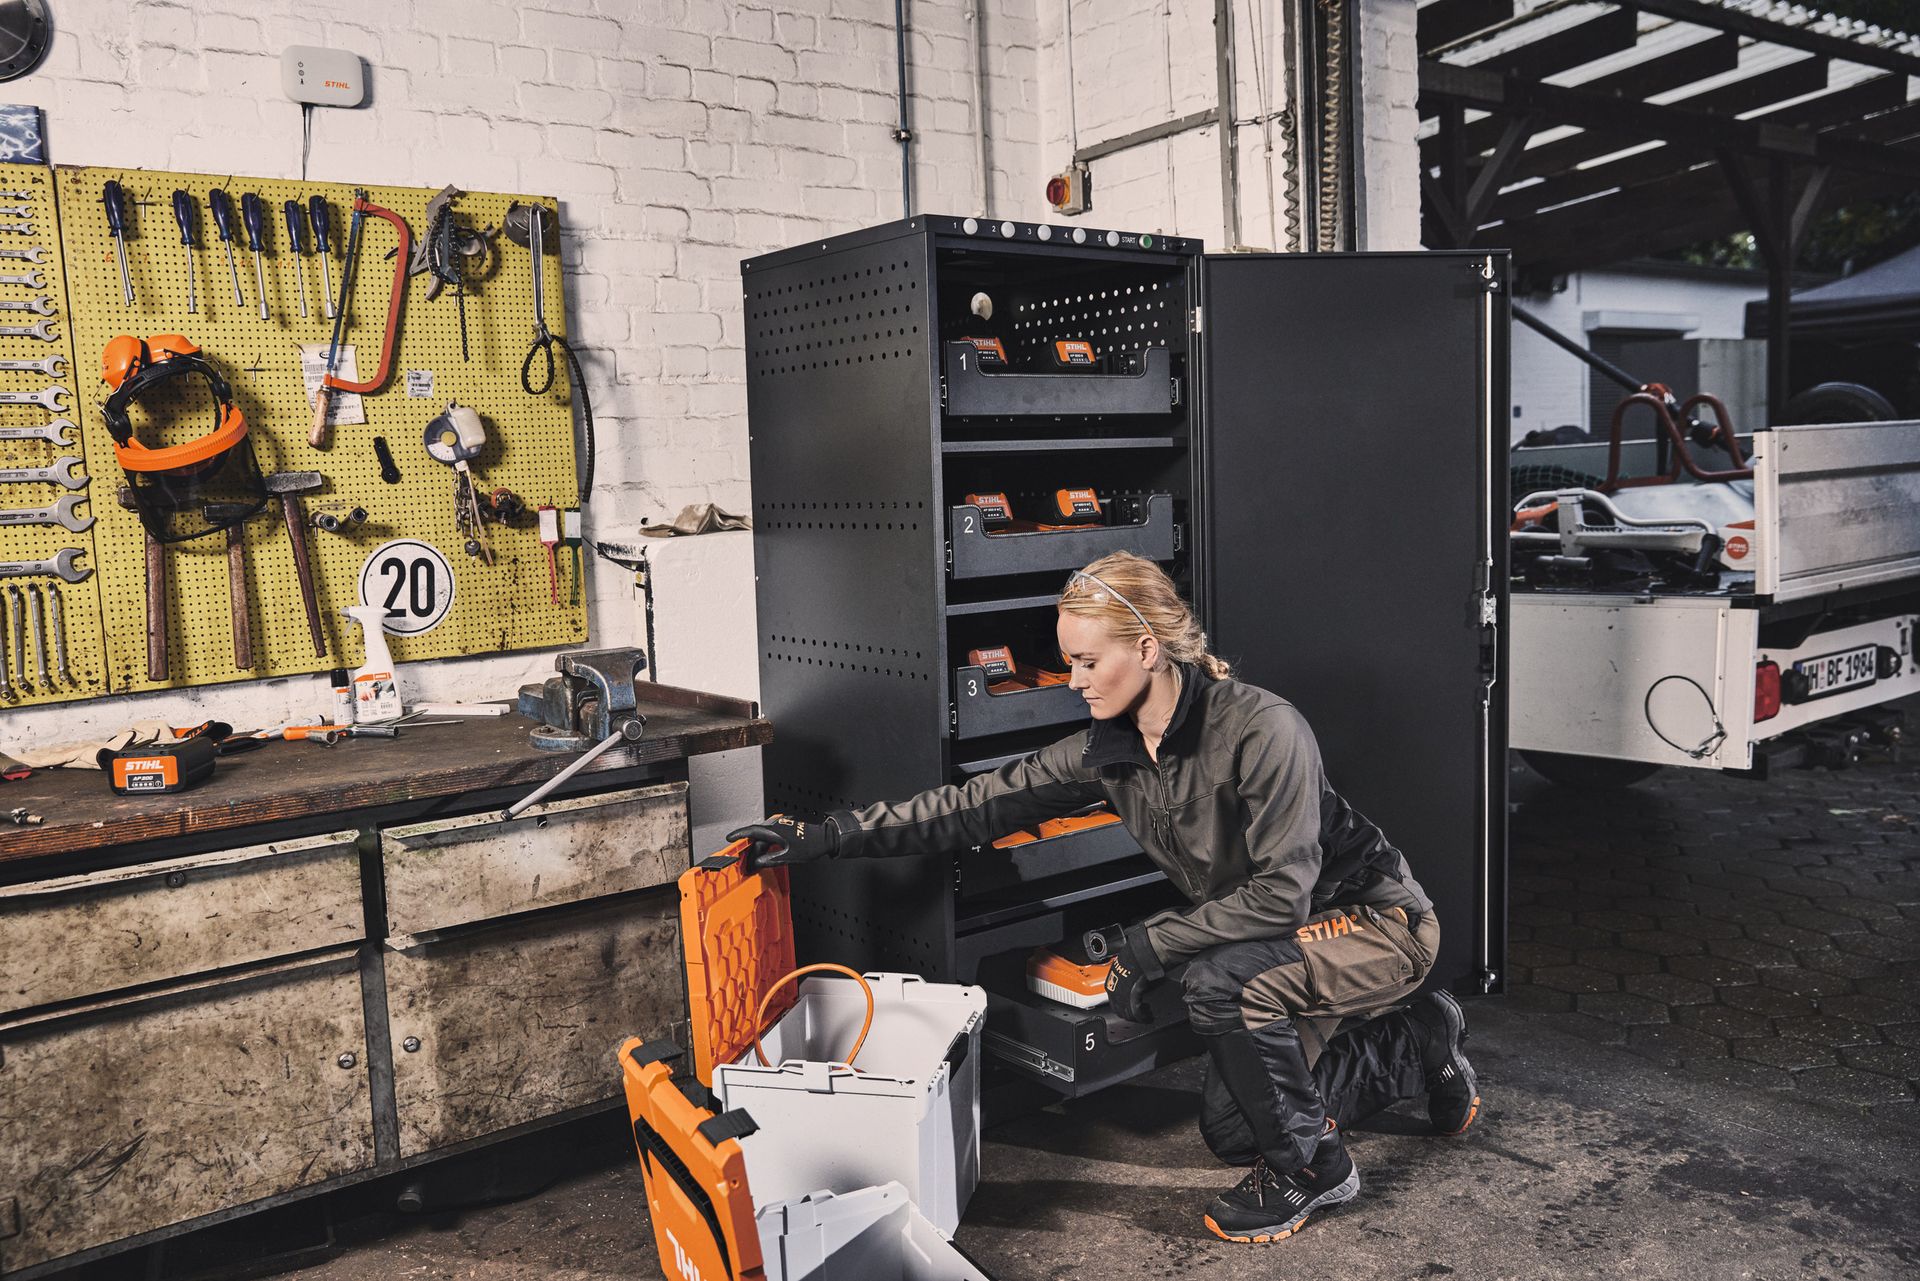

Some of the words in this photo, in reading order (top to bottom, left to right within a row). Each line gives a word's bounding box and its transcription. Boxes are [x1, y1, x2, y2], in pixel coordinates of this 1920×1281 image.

[324, 80, 351, 89] STIHL
[991, 225, 997, 233] 2
[1097, 234, 1102, 242] 5
[973, 339, 997, 347] STIHL
[959, 352, 967, 371] 1
[1069, 490, 1092, 499] STIHL
[978, 496, 1002, 504] STIHL
[964, 516, 974, 533] 2
[380, 557, 435, 618] 20
[982, 650, 1006, 659] STIHL
[1827, 657, 1843, 687] BF
[1845, 650, 1873, 682] 1984
[967, 680, 977, 696] 3
[125, 760, 164, 770] STIHL
[1296, 914, 1365, 943] STIHL
[1085, 1032, 1095, 1051] 5
